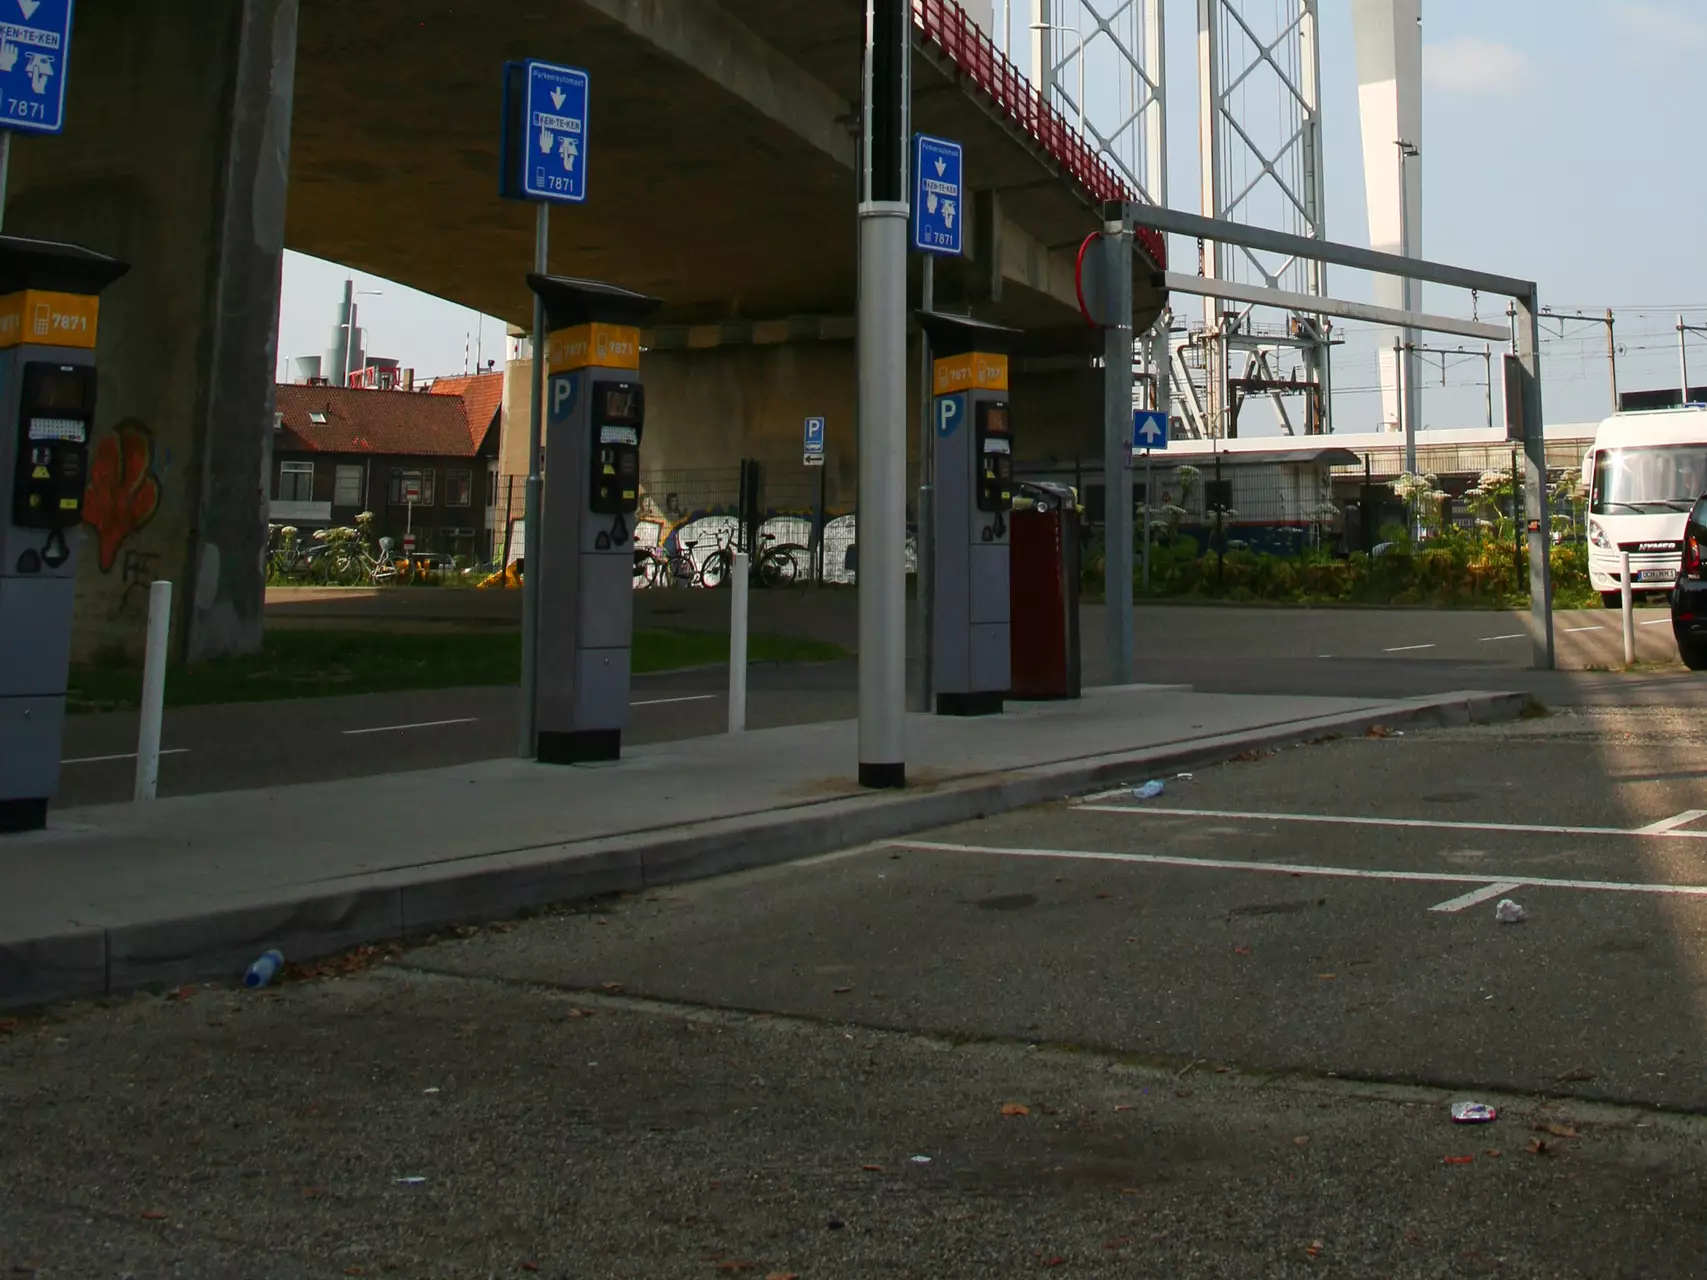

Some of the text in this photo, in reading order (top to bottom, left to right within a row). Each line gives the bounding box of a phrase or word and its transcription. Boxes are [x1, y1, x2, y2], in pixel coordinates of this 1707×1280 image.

[8, 98, 45, 119] 7871
[548, 175, 574, 192] 7871
[934, 231, 953, 246] 7871
[51, 313, 87, 332] 7871
[609, 341, 633, 355] 7871
[554, 378, 571, 415] P
[940, 399, 957, 430] P
[808, 419, 820, 439] P
